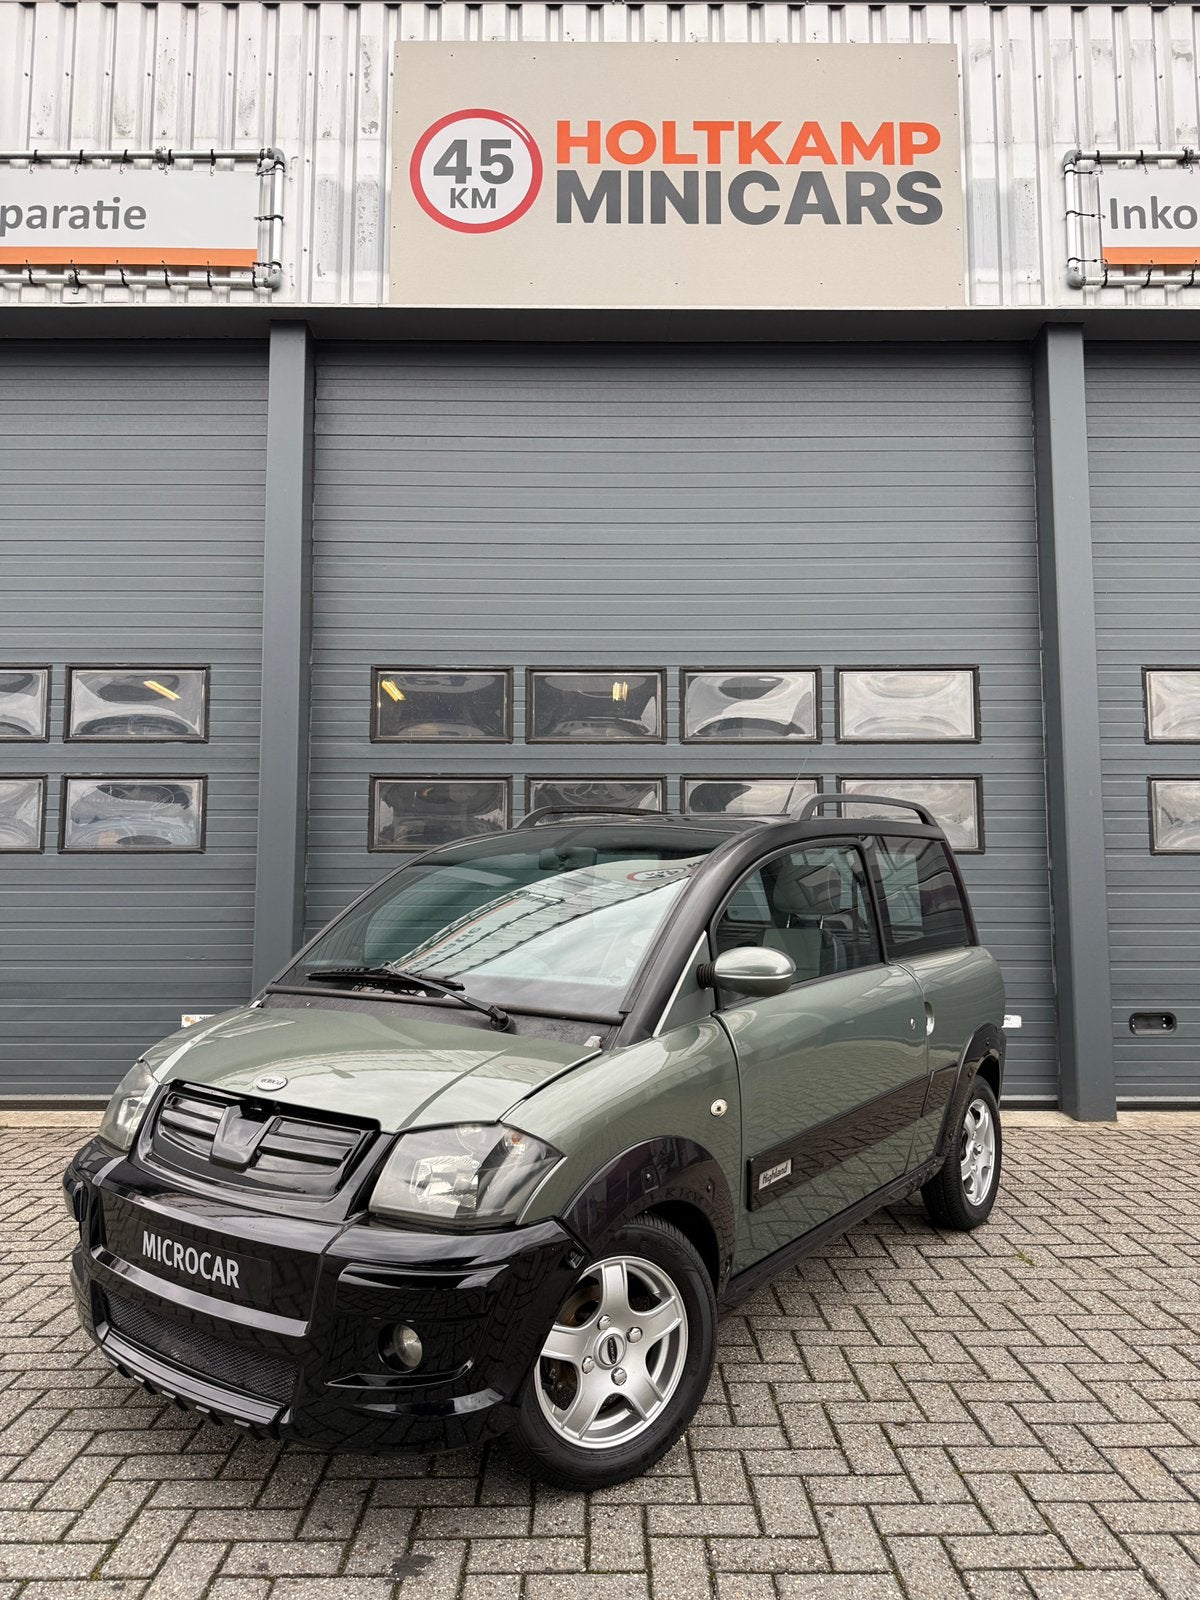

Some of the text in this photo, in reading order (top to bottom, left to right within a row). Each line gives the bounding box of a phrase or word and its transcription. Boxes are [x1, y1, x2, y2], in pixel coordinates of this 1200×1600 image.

[433, 139, 515, 185] 45
[556, 120, 941, 165] HOLTKAMP
[0, 196, 147, 237] paratie
[450, 187, 497, 209] KM
[556, 170, 943, 225] MINICARS
[1109, 195, 1198, 230] Inko
[762, 1162, 789, 1185] Highland
[142, 1230, 240, 1289] MICROCAR
